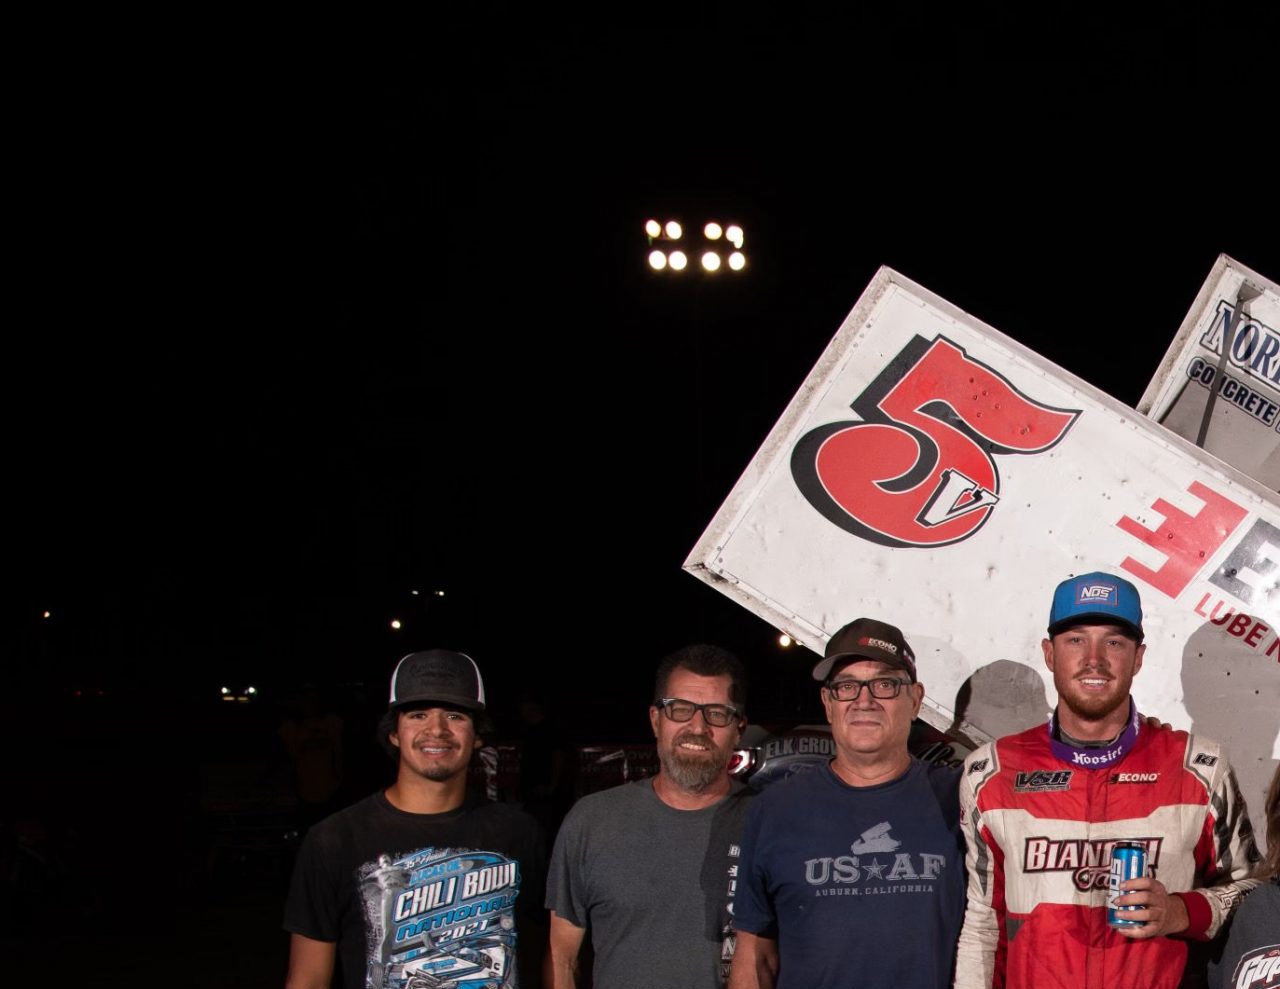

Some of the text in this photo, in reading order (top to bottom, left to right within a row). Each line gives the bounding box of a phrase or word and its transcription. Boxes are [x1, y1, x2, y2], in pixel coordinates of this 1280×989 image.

[791, 334, 1082, 548] 5
[1080, 585, 1113, 598] NOS
[1193, 592, 1269, 648] LUBE
[867, 637, 898, 653] ECONO
[766, 735, 836, 759] ELK GRO
[1072, 746, 1122, 765] Hoosier
[1118, 773, 1158, 781] ECONO
[1023, 836, 1164, 873] BIANI
[395, 863, 516, 921] CHILI BOWL
[865, 884, 934, 895] CALIFORNIA
[438, 919, 488, 943] 2021
